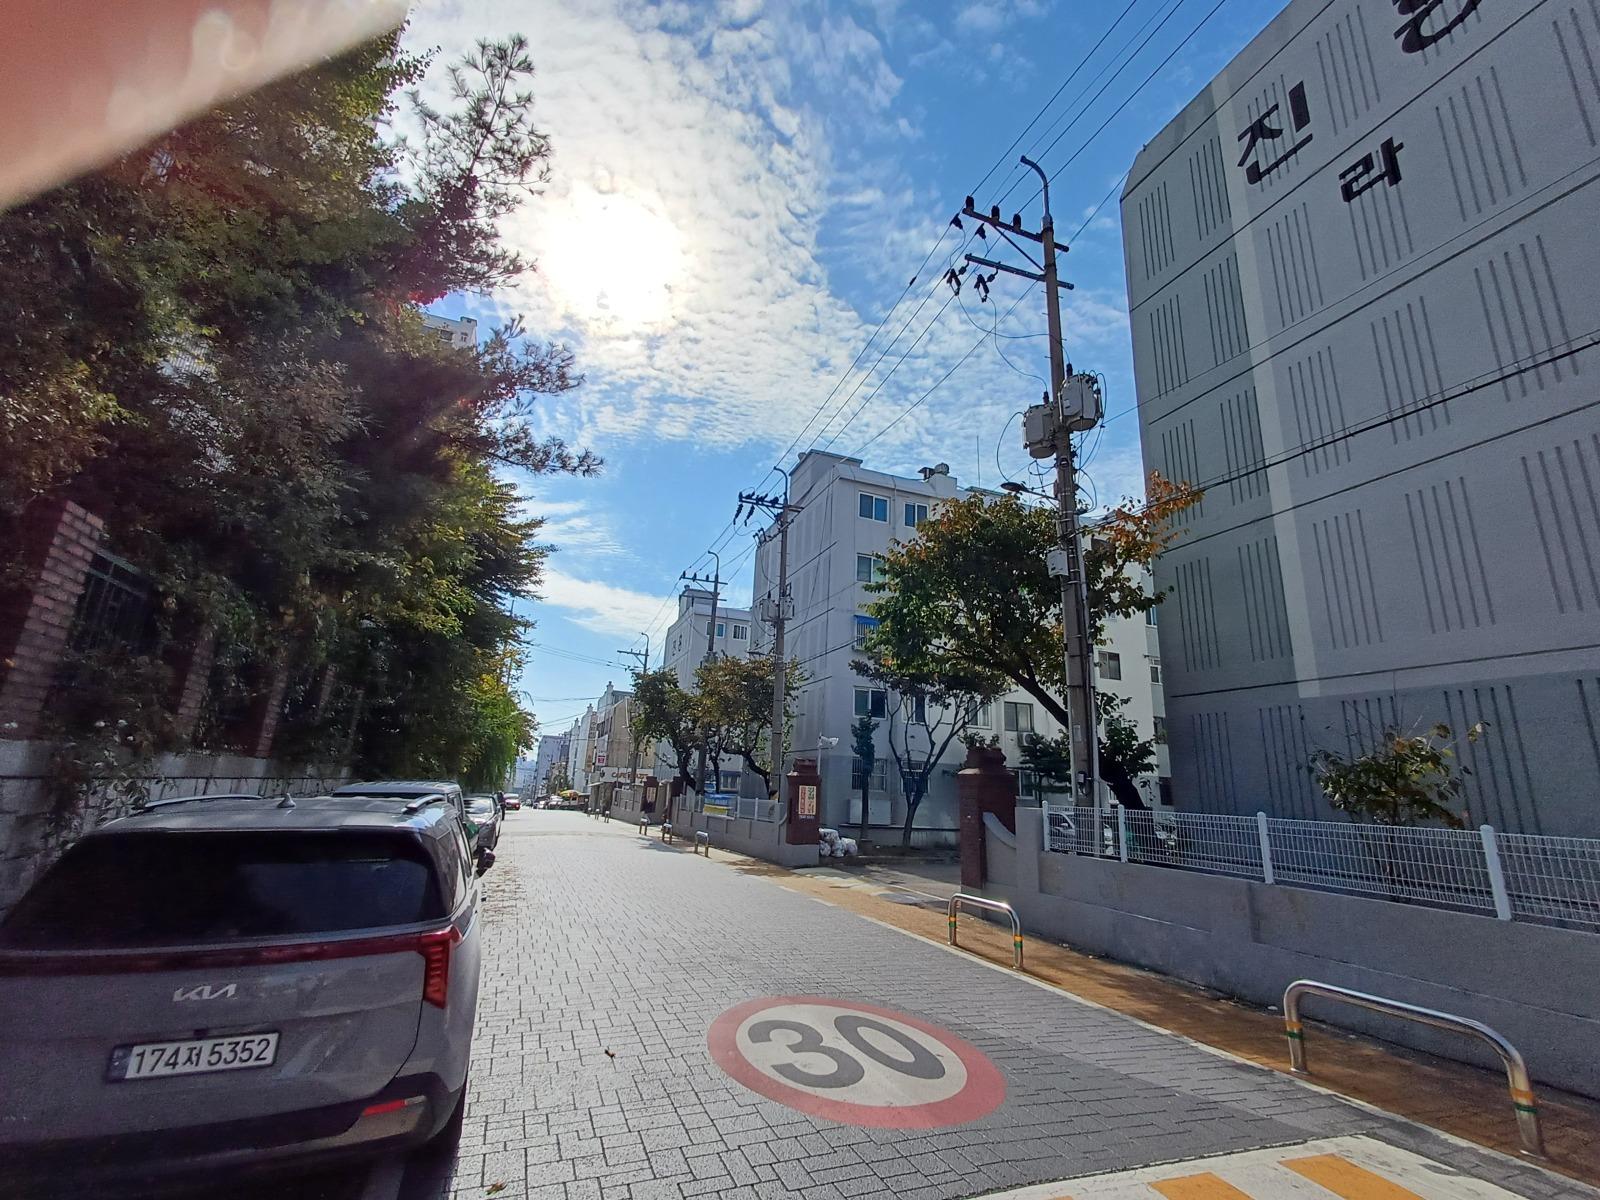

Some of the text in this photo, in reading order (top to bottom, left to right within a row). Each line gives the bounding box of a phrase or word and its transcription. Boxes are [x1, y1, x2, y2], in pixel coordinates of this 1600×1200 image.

[1339, 137, 1404, 203] 라
[173, 983, 237, 1002] KIA
[748, 1015, 946, 1089] 30
